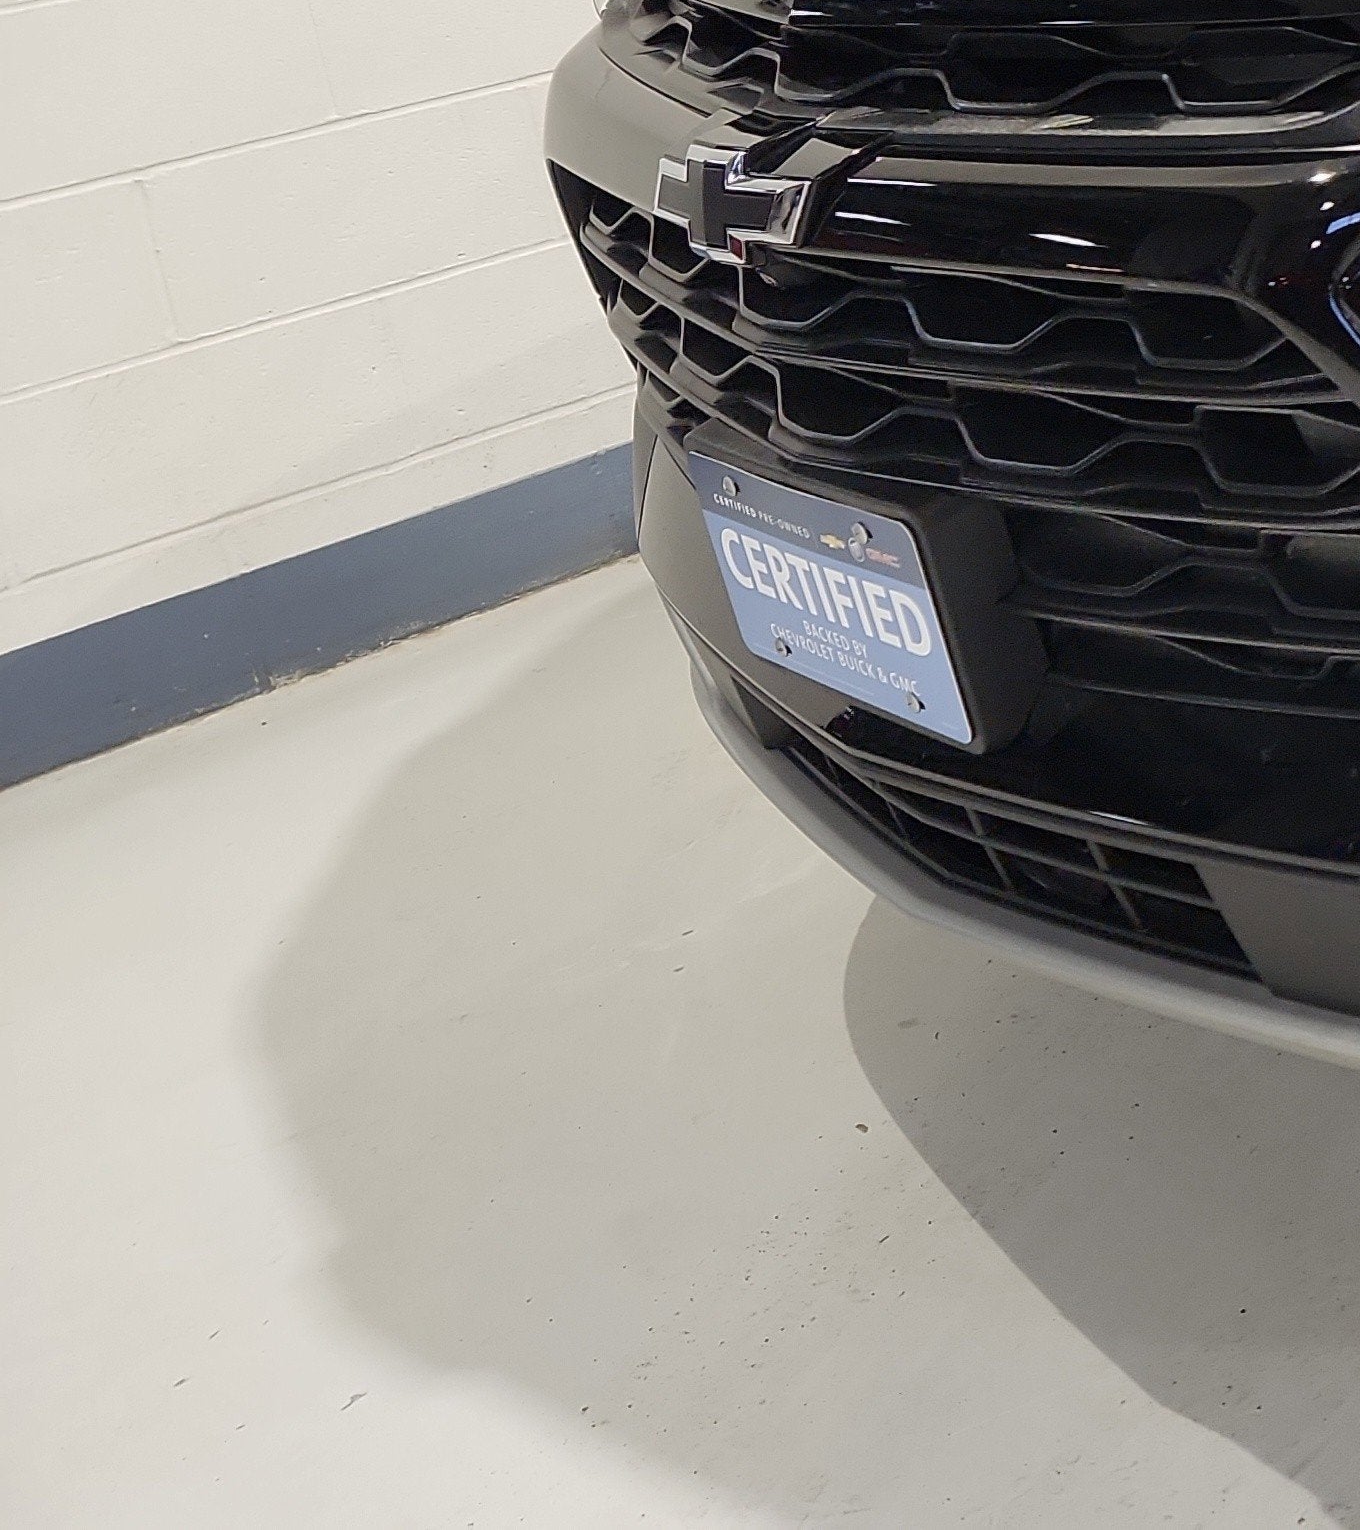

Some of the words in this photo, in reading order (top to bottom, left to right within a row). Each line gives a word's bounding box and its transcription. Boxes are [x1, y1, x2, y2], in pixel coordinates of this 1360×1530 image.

[713, 492, 757, 519] CERTIFIED
[758, 509, 811, 539] PRE-OWNED
[720, 528, 932, 657] CERTIFIED
[770, 623, 835, 663] CHEVROLET
[837, 651, 877, 680] BUICK
[877, 667, 889, 684] &
[889, 672, 921, 697] GMC
[802, 620, 850, 652] BACKED
[851, 639, 869, 659] BY
